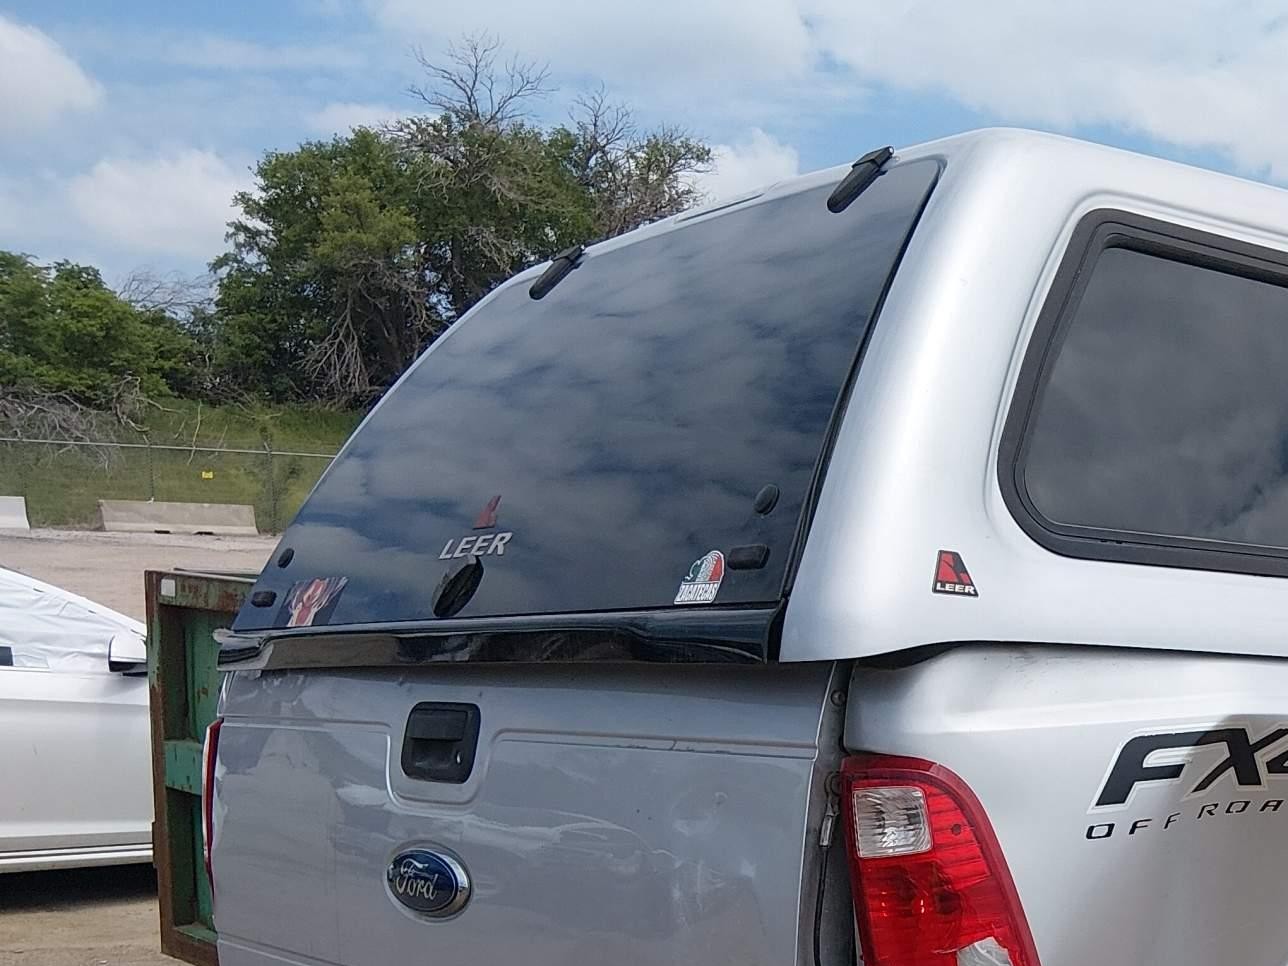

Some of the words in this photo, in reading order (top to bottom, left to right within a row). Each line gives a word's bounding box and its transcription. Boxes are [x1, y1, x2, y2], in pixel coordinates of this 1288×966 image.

[438, 531, 513, 560] LEER
[935, 582, 976, 595] LEER
[1086, 812, 1181, 840] OFF
[396, 858, 440, 900] Ford
